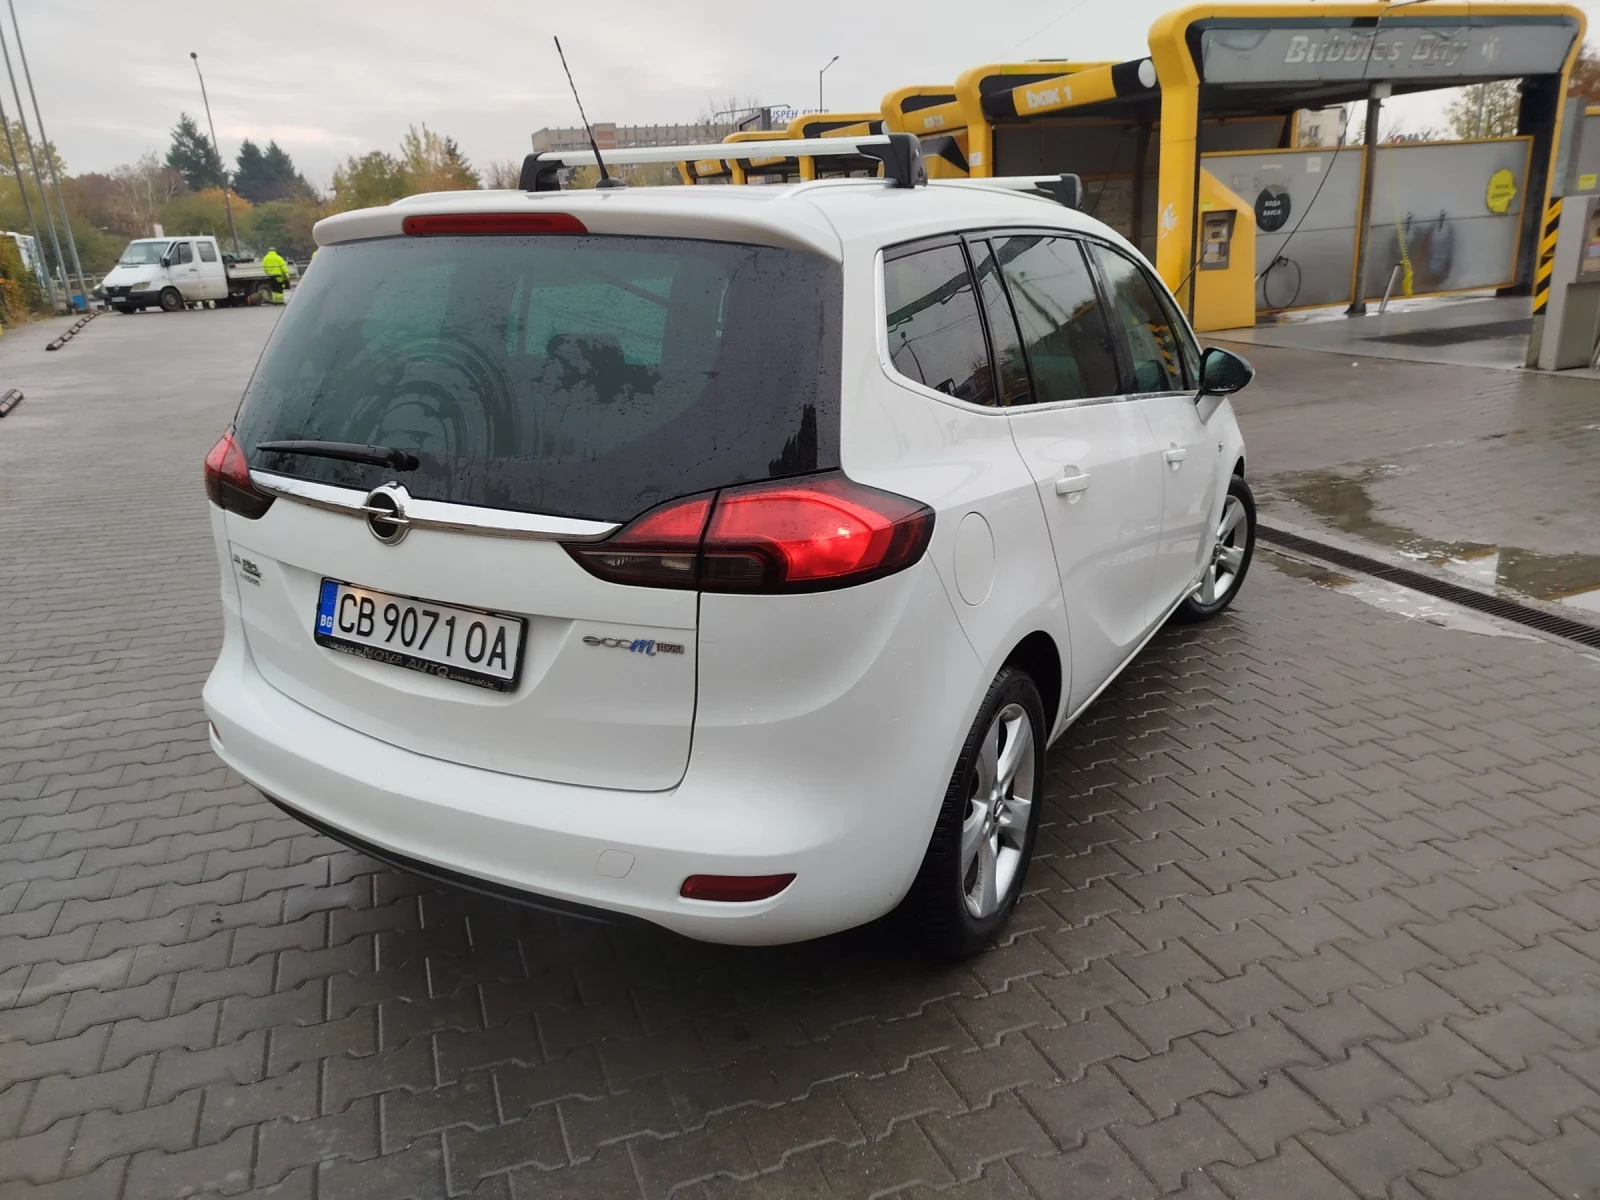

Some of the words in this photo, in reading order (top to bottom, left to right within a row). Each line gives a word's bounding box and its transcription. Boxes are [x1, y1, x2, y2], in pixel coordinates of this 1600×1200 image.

[1284, 35, 1403, 63] Bubbles
[1026, 88, 1061, 109] box
[1064, 85, 1073, 102] 1
[320, 614, 333, 627] BG
[338, 593, 375, 637] CB
[383, 603, 457, 657] 9071
[363, 646, 403, 665] NOVA
[406, 658, 449, 678] AUTO
